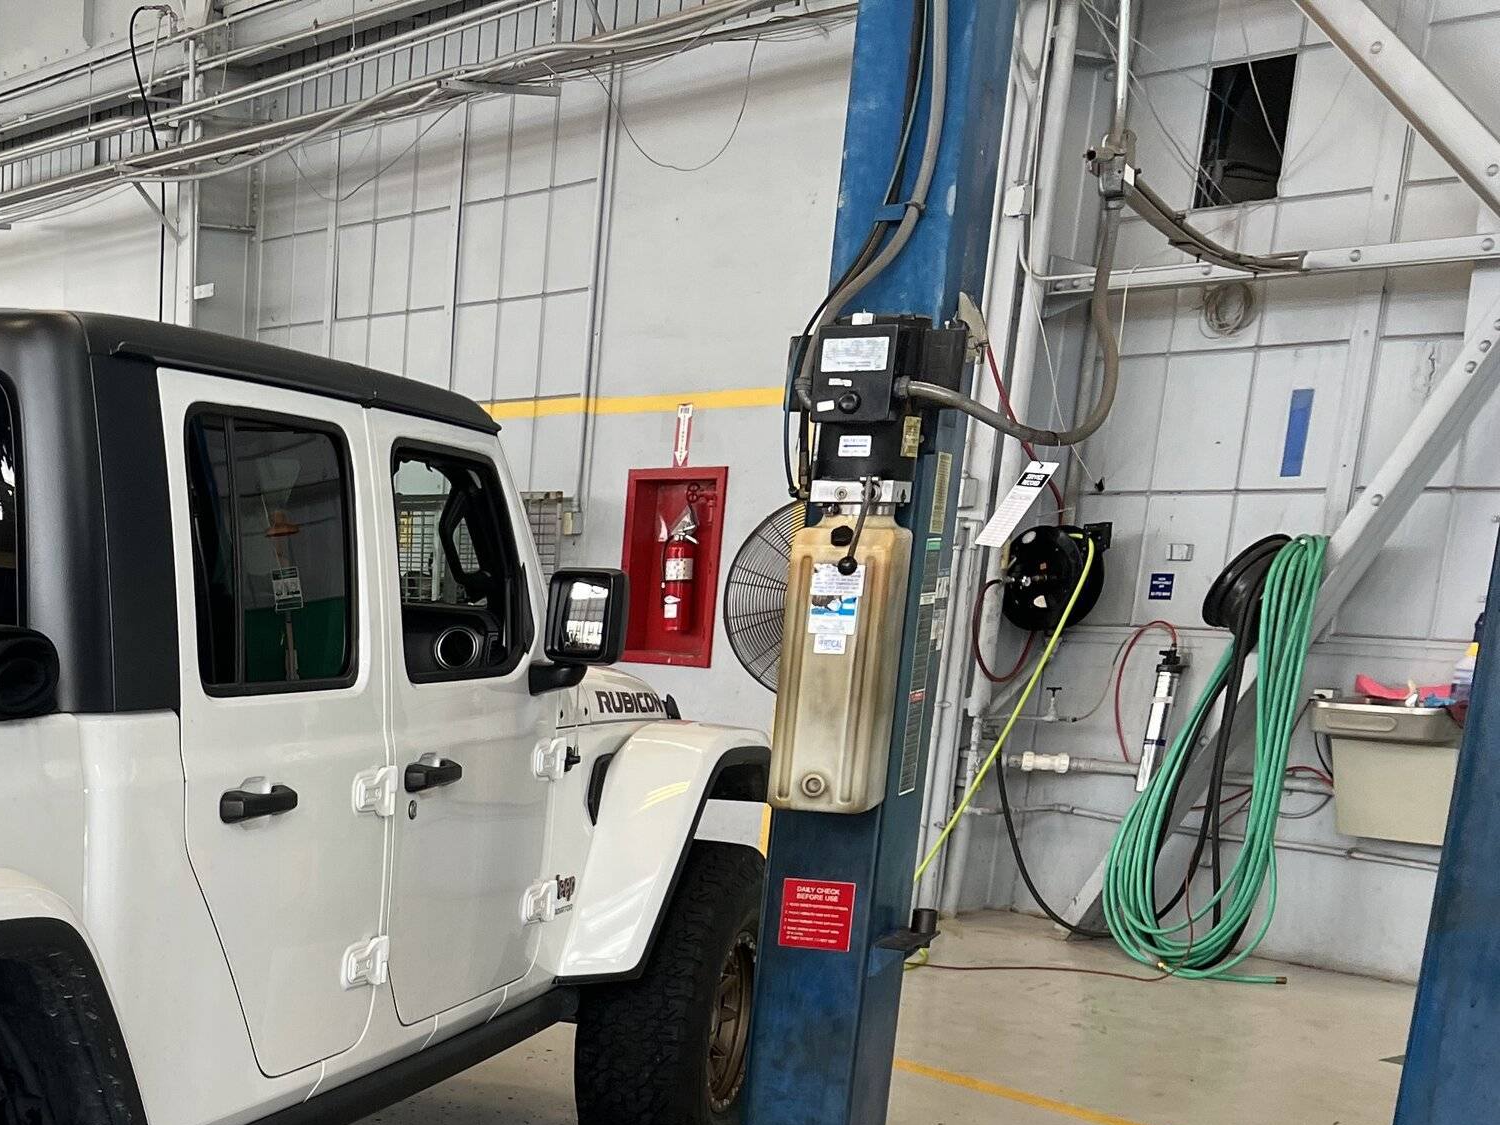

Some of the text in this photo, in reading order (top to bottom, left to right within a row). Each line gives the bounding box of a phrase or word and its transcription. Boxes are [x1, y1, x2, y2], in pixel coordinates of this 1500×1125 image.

[595, 689, 664, 714] RUBICON
[816, 887, 840, 895] CHECK
[796, 893, 839, 902] BEFORE USE
